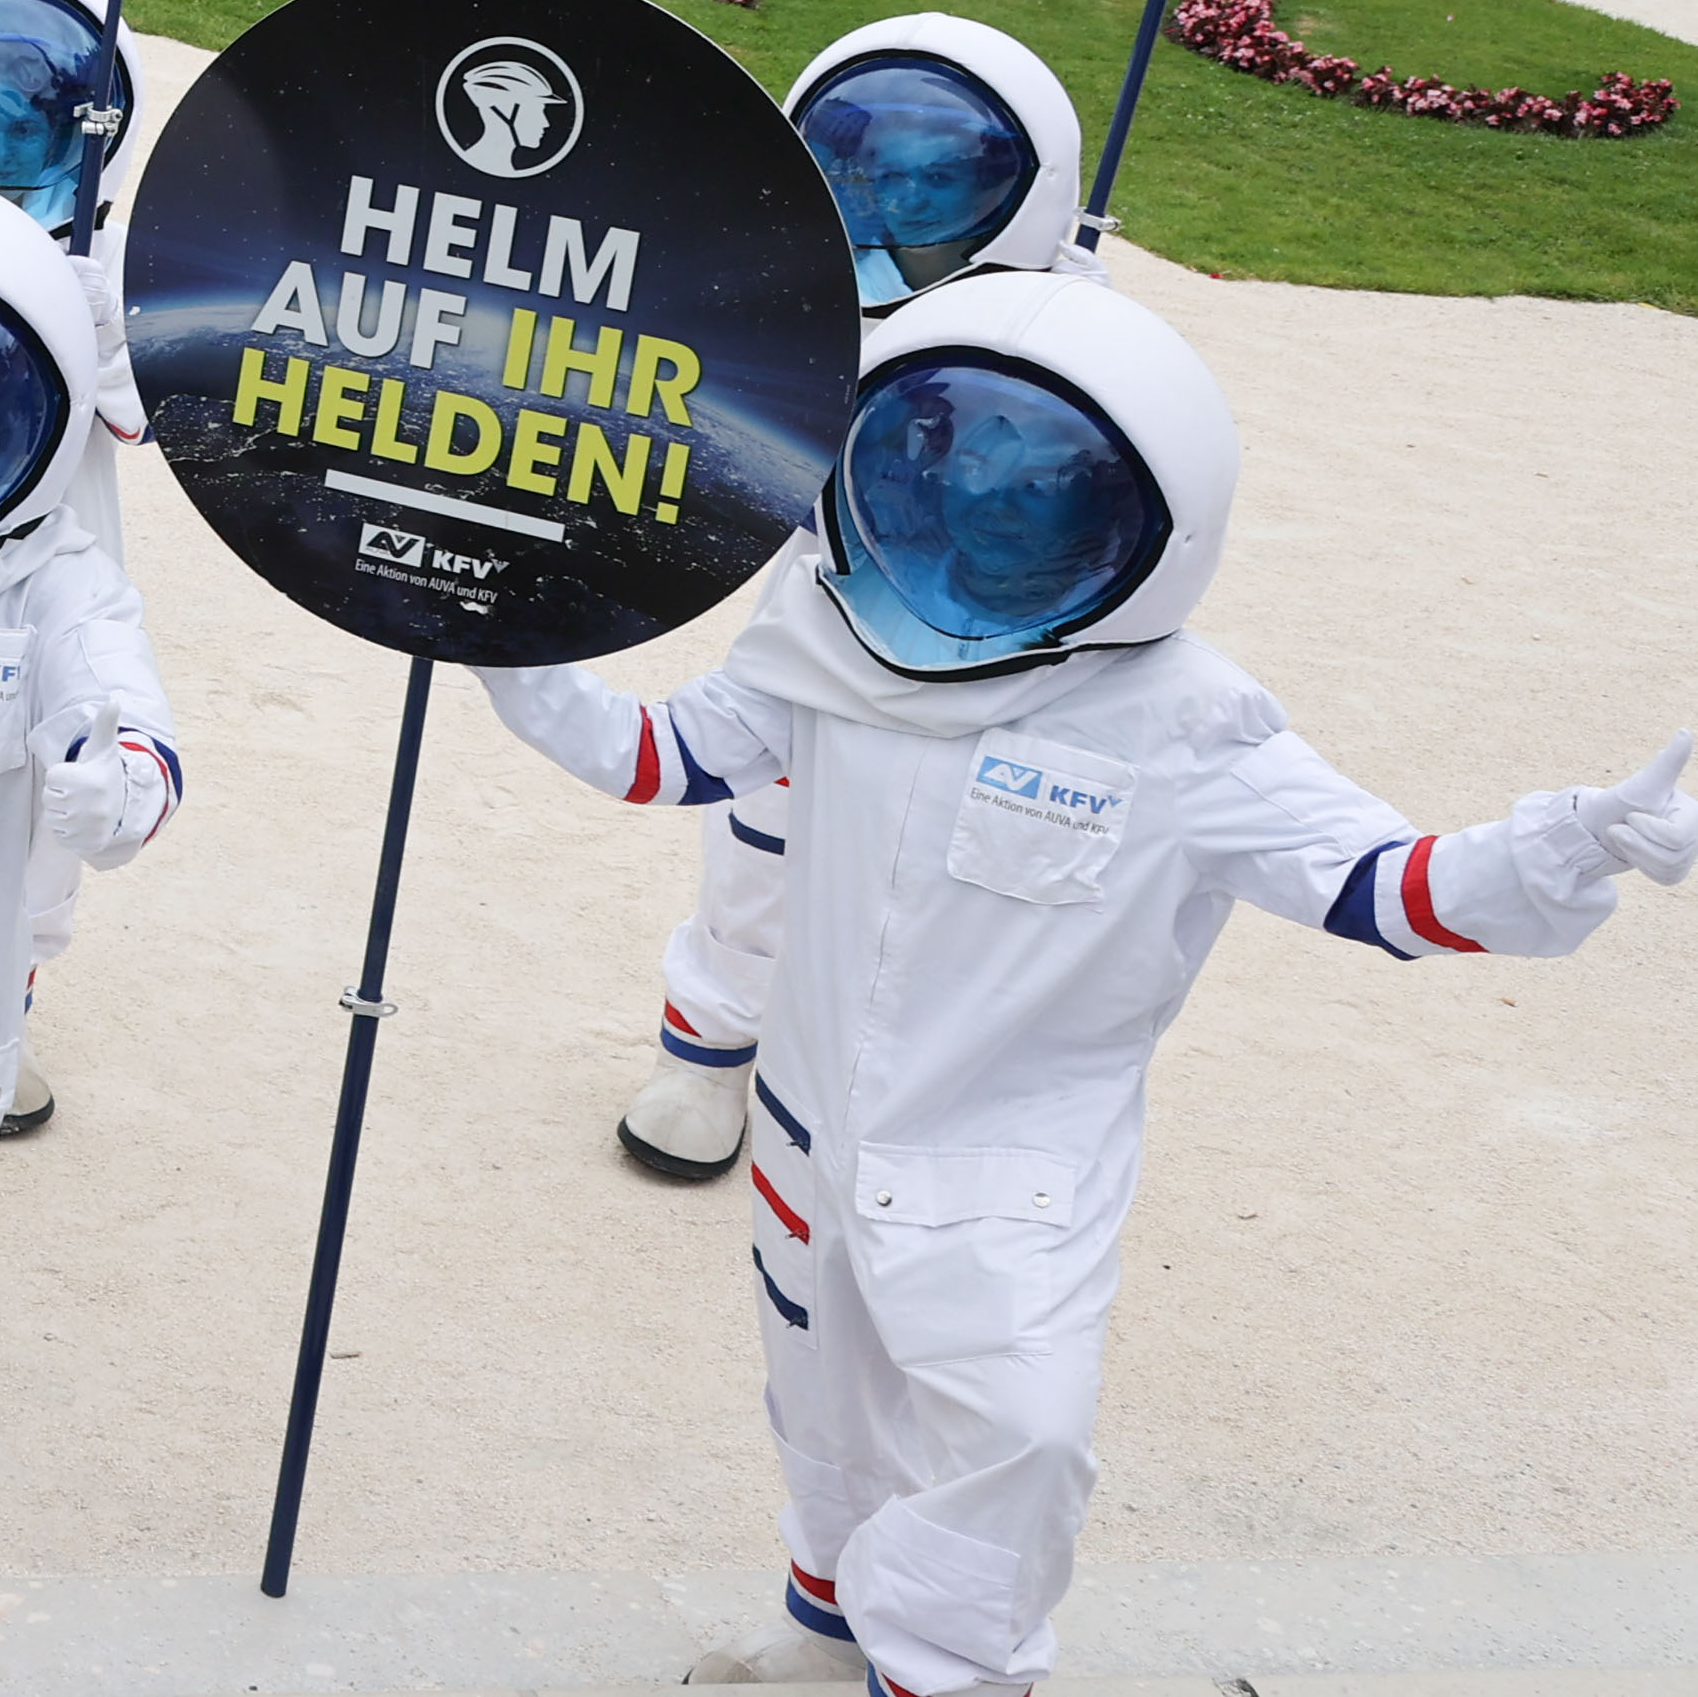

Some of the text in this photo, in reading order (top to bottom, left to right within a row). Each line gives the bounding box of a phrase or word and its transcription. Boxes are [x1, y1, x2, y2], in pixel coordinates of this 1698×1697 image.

[339, 174, 641, 313] HELM
[251, 259, 702, 428] AUF IHR
[231, 346, 691, 527] HELDEN!
[355, 558, 498, 604] Eine Aktion von AUVA und KFV
[432, 549, 493, 580] KFV
[971, 788, 990, 801] Eine
[992, 793, 1022, 814] Aktion
[1025, 806, 1043, 819] von
[1044, 810, 1071, 828] AUVA
[1049, 785, 1107, 814] KFV
